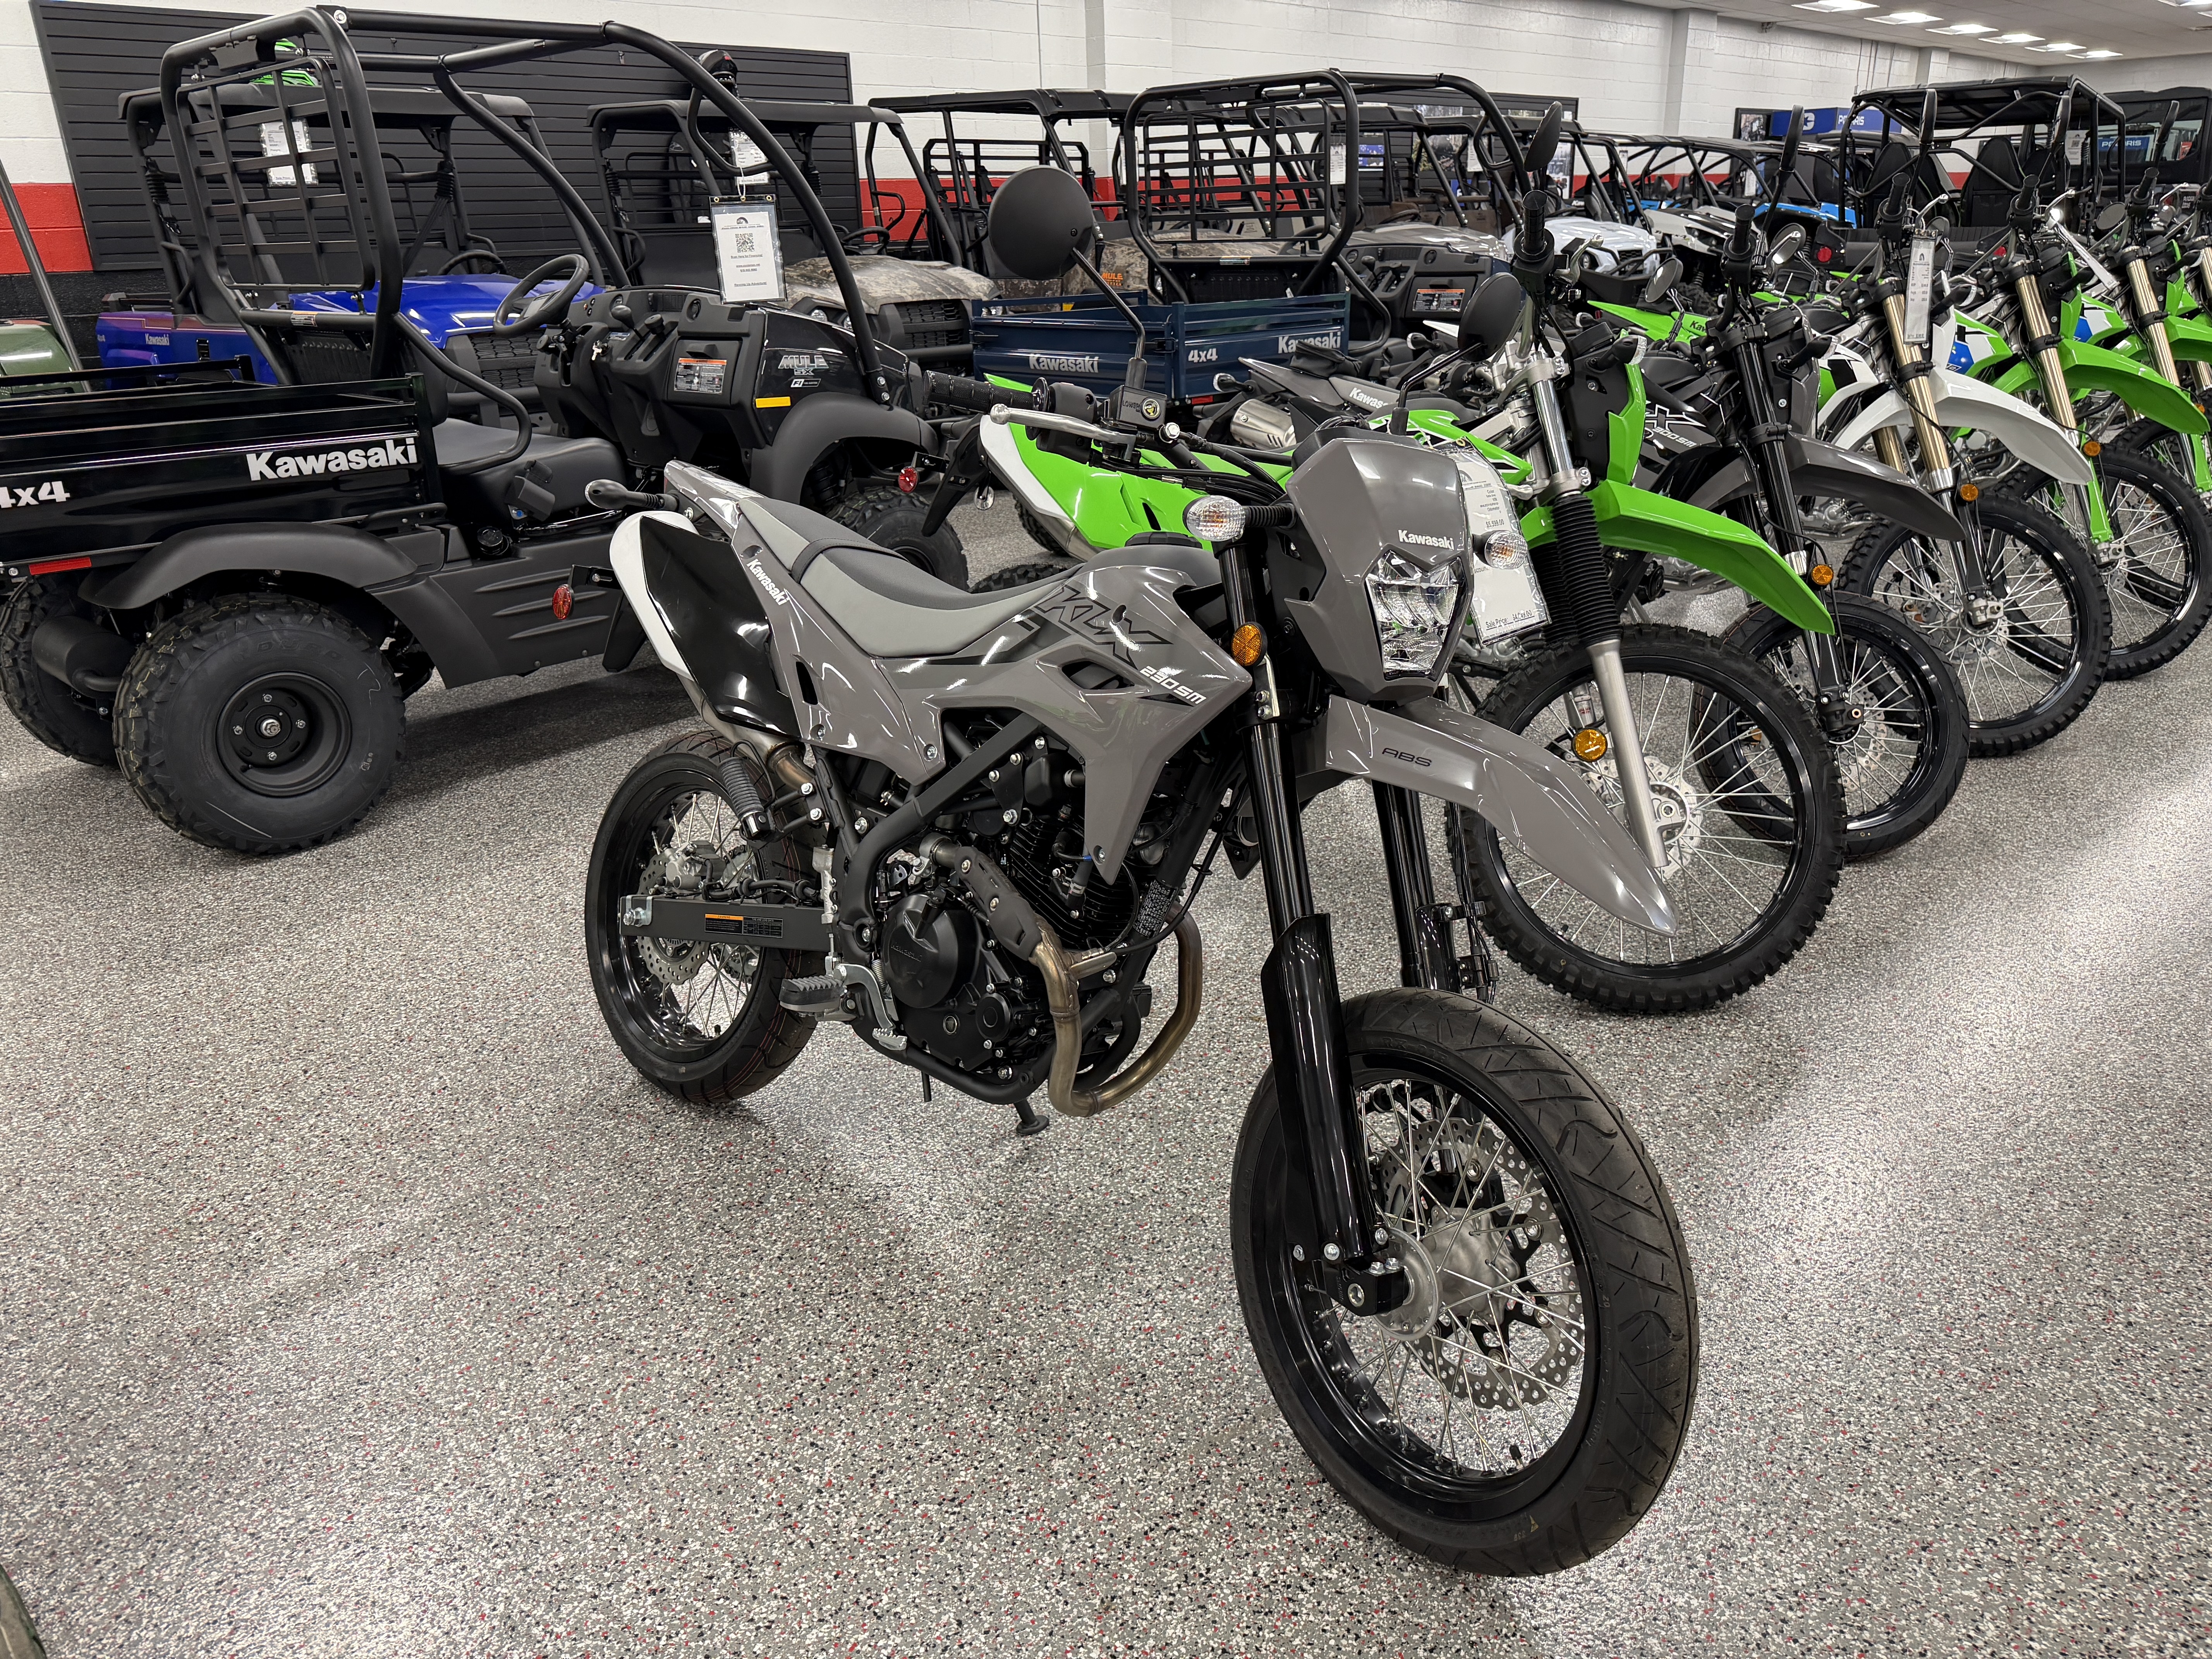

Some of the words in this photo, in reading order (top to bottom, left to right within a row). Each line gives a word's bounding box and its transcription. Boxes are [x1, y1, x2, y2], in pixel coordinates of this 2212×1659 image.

[145, 333, 169, 345] Kawasaki
[778, 355, 829, 369] MULE
[1029, 354, 1099, 373] Kawasaki
[1188, 348, 1218, 363] 4x4
[1349, 388, 1388, 409] Kawas
[1652, 427, 1697, 447] 300SM
[0, 481, 70, 508] 4x4
[246, 438, 417, 481] Kawasaki
[1398, 529, 1455, 550] Kawasaki
[746, 558, 790, 605] Kawasaki
[1034, 584, 1174, 670] KLX
[1495, 618, 1508, 626] Price:
[1140, 666, 1206, 704] 230SM
[1382, 748, 1432, 766] ABS
